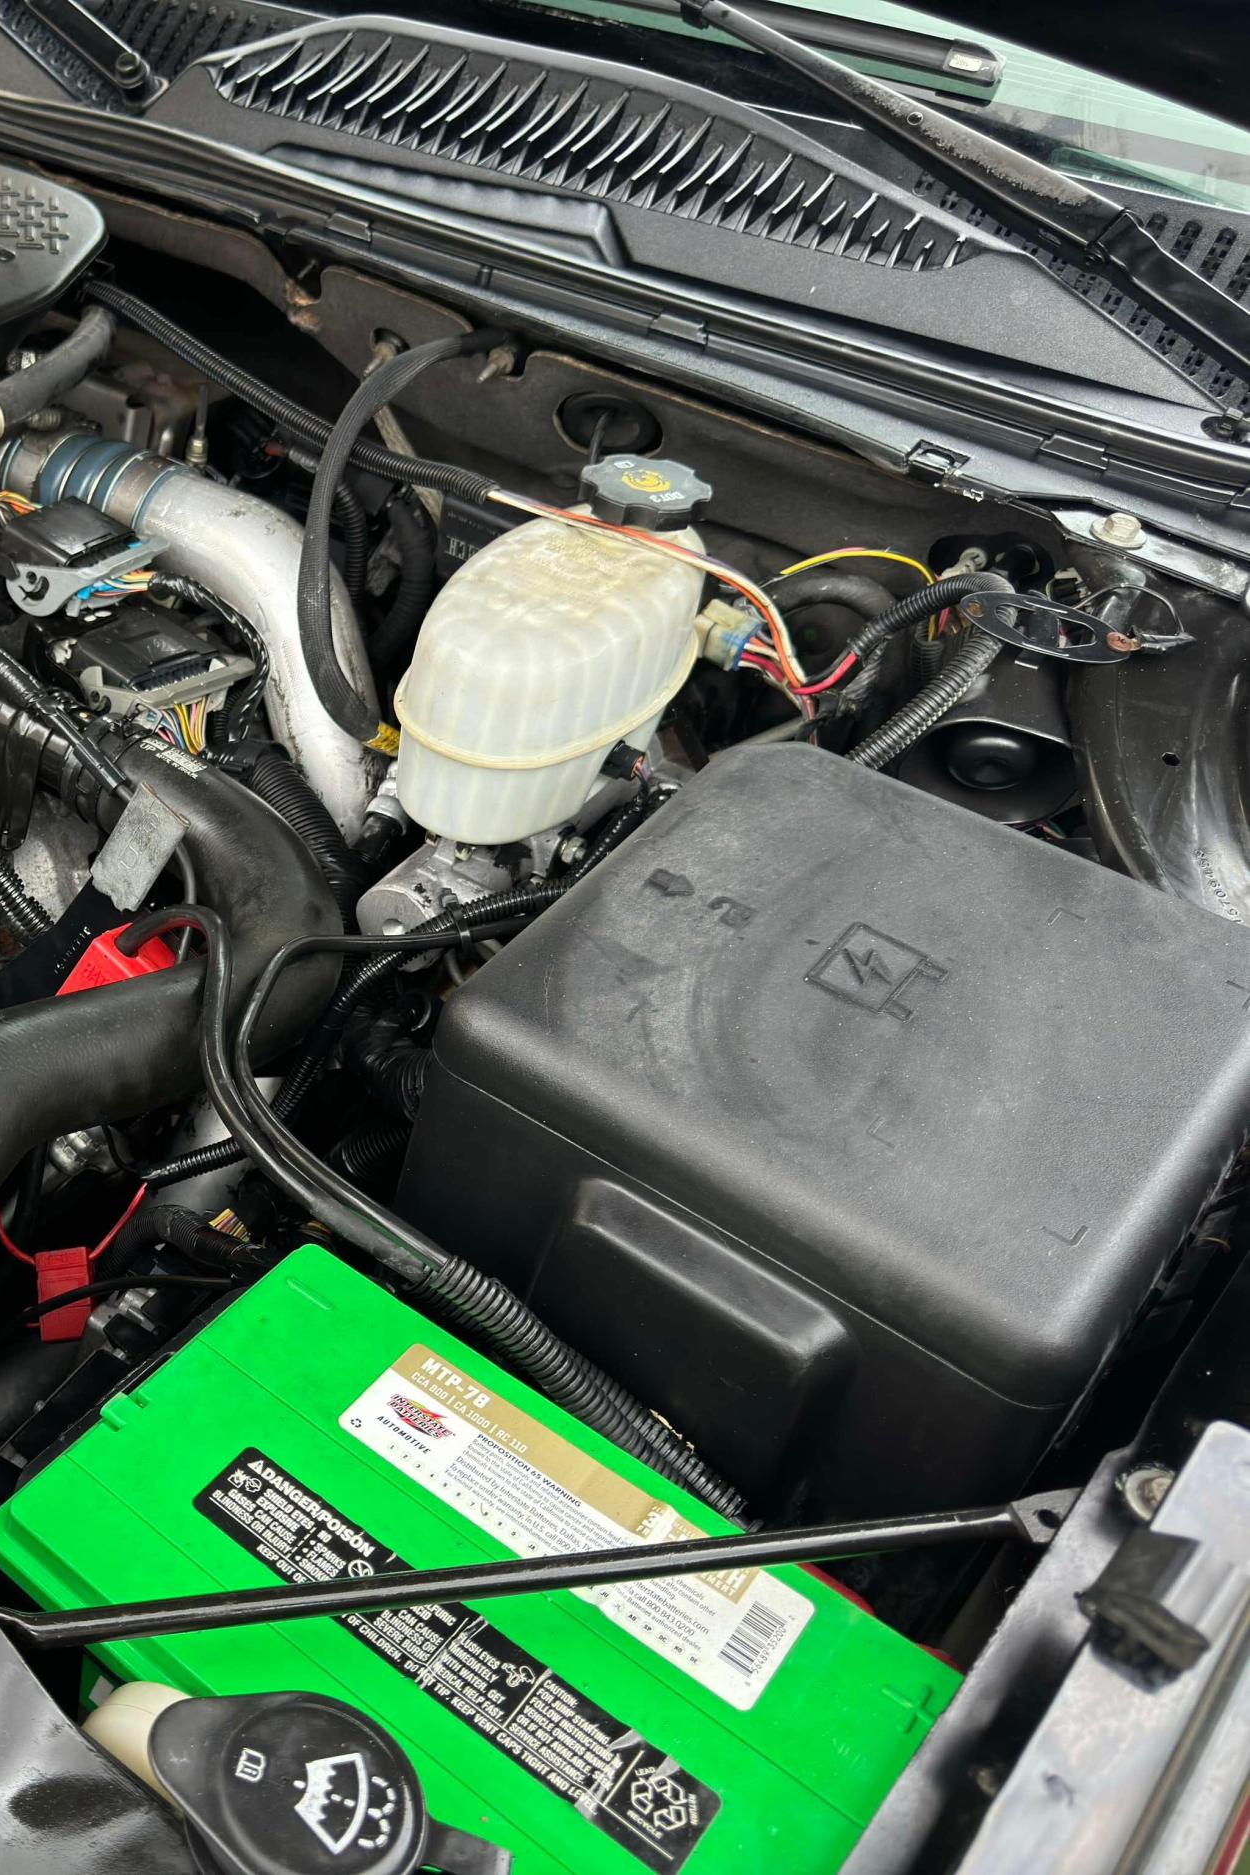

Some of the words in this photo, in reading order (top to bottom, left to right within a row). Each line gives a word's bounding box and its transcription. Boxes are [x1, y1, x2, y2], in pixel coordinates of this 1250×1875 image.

[661, 491, 685, 502] DOT
[420, 1357, 490, 1408] MTP-78
[388, 1401, 441, 1437] BATTERIES
[391, 1394, 452, 1436] INTERSTATE
[411, 1372, 429, 1386] CCA
[428, 1384, 448, 1399] 800
[453, 1401, 467, 1412] CA
[466, 1410, 490, 1428] 1000
[495, 1430, 510, 1441] RC
[509, 1438, 527, 1452] 110
[375, 1415, 431, 1454] AUTOMOTIVE
[477, 1434, 530, 1471] PROPOSITION
[530, 1470, 541, 1478] 65
[541, 1478, 581, 1506] WARNING
[211, 1489, 254, 1524] BLINDNESS
[250, 1520, 265, 1532] OR
[261, 1529, 292, 1554] INJURY
[227, 1488, 256, 1511] GASES
[253, 1508, 272, 1524] CAN
[269, 1521, 296, 1543] CAUSE
[255, 1496, 300, 1531] EXPLOSIVE
[260, 1466, 375, 1557] DANGER/POISON
[262, 1488, 293, 1513] SHIELD
[290, 1509, 314, 1529] EYES
[455, 1456, 492, 1482] Distributed
[490, 1480, 500, 1489] by
[499, 1487, 530, 1509] Interstate
[528, 1507, 561, 1530] Batteries,
[559, 1529, 582, 1545] Dallas,
[456, 1469, 480, 1486] replace
[478, 1484, 499, 1499] under
[496, 1498, 525, 1518] warranty,
[544, 1530, 557, 1540] call
[313, 1542, 346, 1569] SPARKS
[316, 1530, 332, 1543] NO
[305, 1550, 339, 1577] FLAMES
[380, 1609, 424, 1644] BLINDNESS
[421, 1641, 435, 1653] OR
[397, 1609, 417, 1626] CAN
[414, 1621, 443, 1646] CAUSE
[410, 1602, 431, 1620] ACID
[423, 1599, 456, 1625] LFURIC
[626, 1597, 652, 1616] Batteries
[651, 1615, 682, 1637] authorized
[633, 1592, 646, 1602] call
[645, 1601, 695, 1636] 800.843.0200
[698, 1604, 715, 1616] other
[373, 1617, 404, 1642] SEVERE
[401, 1638, 429, 1662] BURNS
[455, 1632, 482, 1655] FLUSH
[478, 1650, 500, 1669] EYES
[256, 1544, 279, 1563] KEEP
[275, 1559, 295, 1575] OUT
[292, 1572, 306, 1584] OF
[346, 1615, 361, 1627] OF
[358, 1624, 403, 1660] CHILDREN.
[403, 1659, 419, 1672] DO
[415, 1668, 436, 1686] NOT
[432, 1683, 453, 1699] TIP.
[450, 1696, 475, 1717] KEEP
[472, 1713, 498, 1734] VENT
[495, 1731, 523, 1754] CAPS
[520, 1750, 550, 1775] TIGHT
[546, 1771, 570, 1790] AND
[438, 1651, 462, 1671] WITH
[486, 1688, 506, 1704] GET
[447, 1641, 499, 1683] IMMEDIATELY
[431, 1661, 466, 1689] MEDICAL
[462, 1685, 485, 1705] HELP
[480, 1700, 506, 1721] FAST.
[536, 1687, 554, 1703] FOR
[551, 1698, 575, 1718] JUMP
[543, 1679, 578, 1707] CAUTION:
[522, 1705, 554, 1731] VEHICLE
[551, 1727, 586, 1755] OWNERS
[529, 1696, 561, 1722] FOLLOW
[558, 1718, 613, 1762] INSTRUCTIONS
[508, 1723, 541, 1749] SERVICE
[538, 1745, 586, 1784] ASSISTANCE.
[515, 1714, 530, 1726] OR
[527, 1723, 537, 1732] IF
[534, 1728, 553, 1744] NOT
[550, 1740, 593, 1775] AVAILABLE,
[590, 1770, 613, 1790] SEEK
[635, 1767, 654, 1775] LEAD
[626, 1810, 663, 1839] RECYCLE
